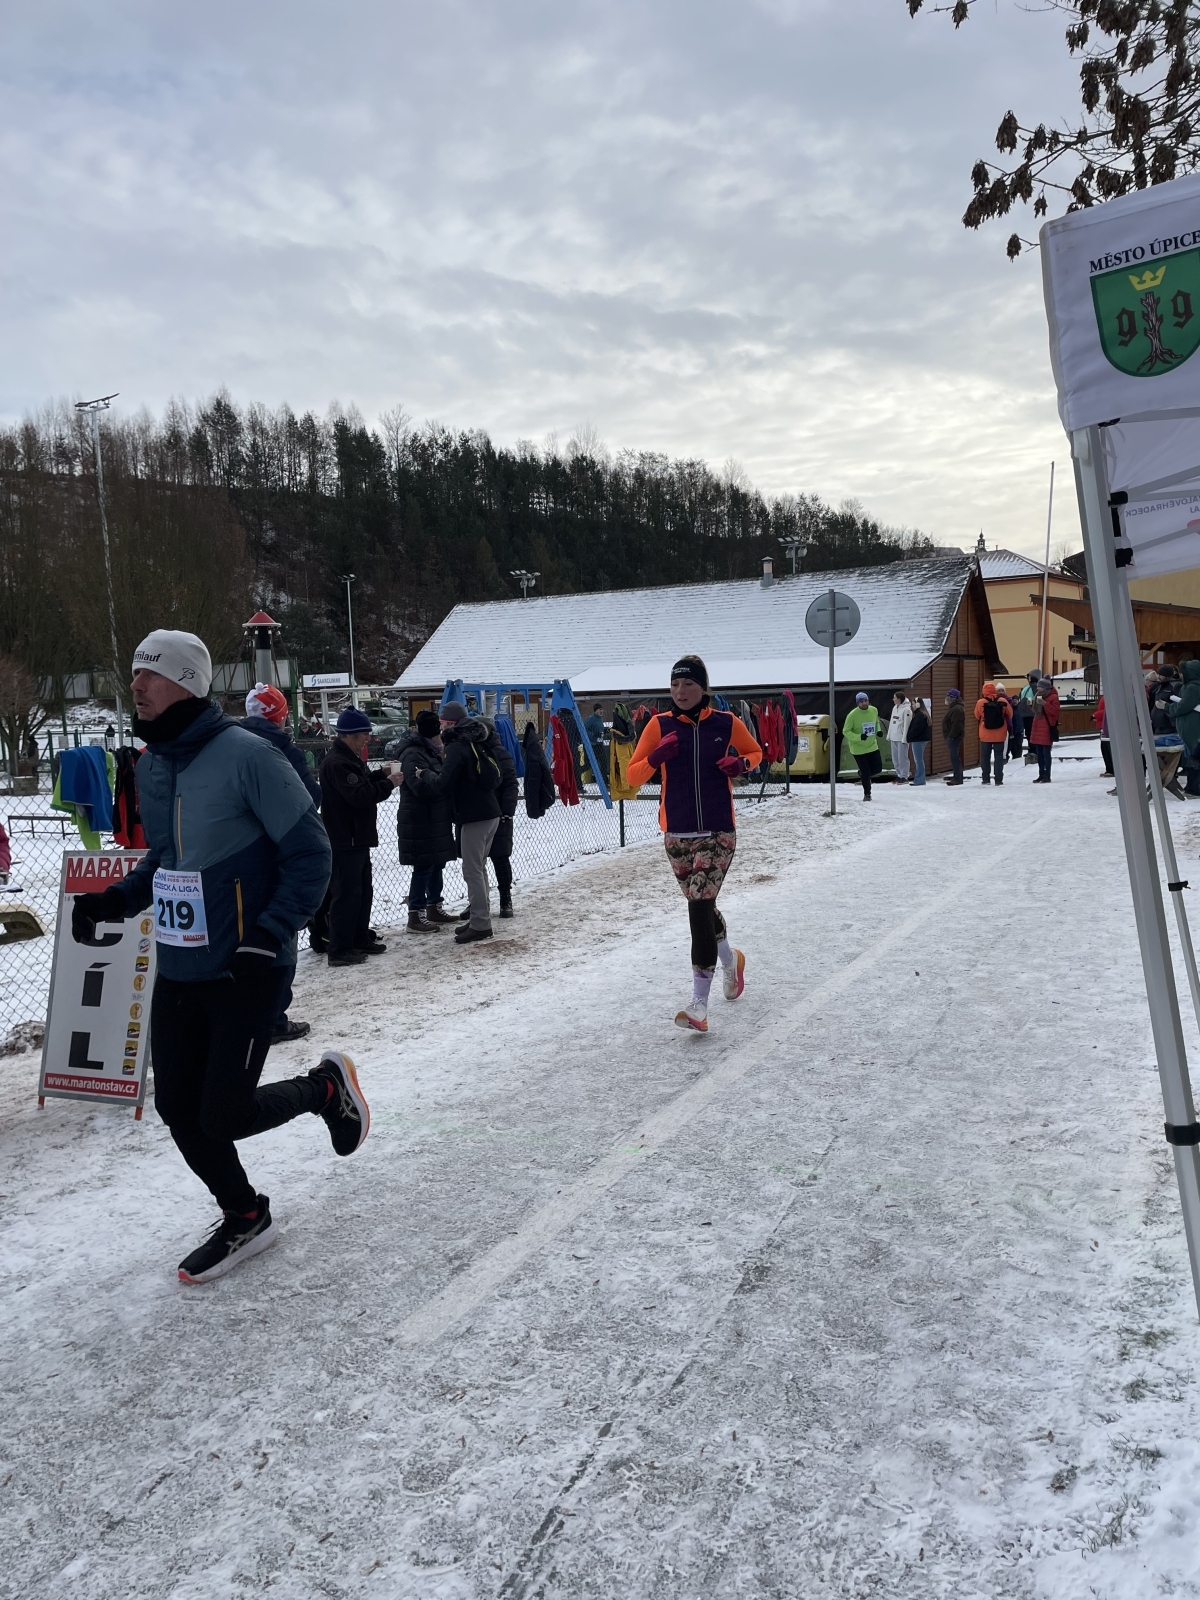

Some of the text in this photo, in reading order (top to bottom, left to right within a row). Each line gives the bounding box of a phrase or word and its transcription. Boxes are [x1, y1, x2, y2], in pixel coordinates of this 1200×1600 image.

[1089, 246, 1146, 273] MĚSTO
[67, 857, 145, 878] MARAT
[179, 885, 200, 893] LIGA
[158, 897, 194, 931] 219
[47, 1075, 135, 1095] www.maratonstav.cz
